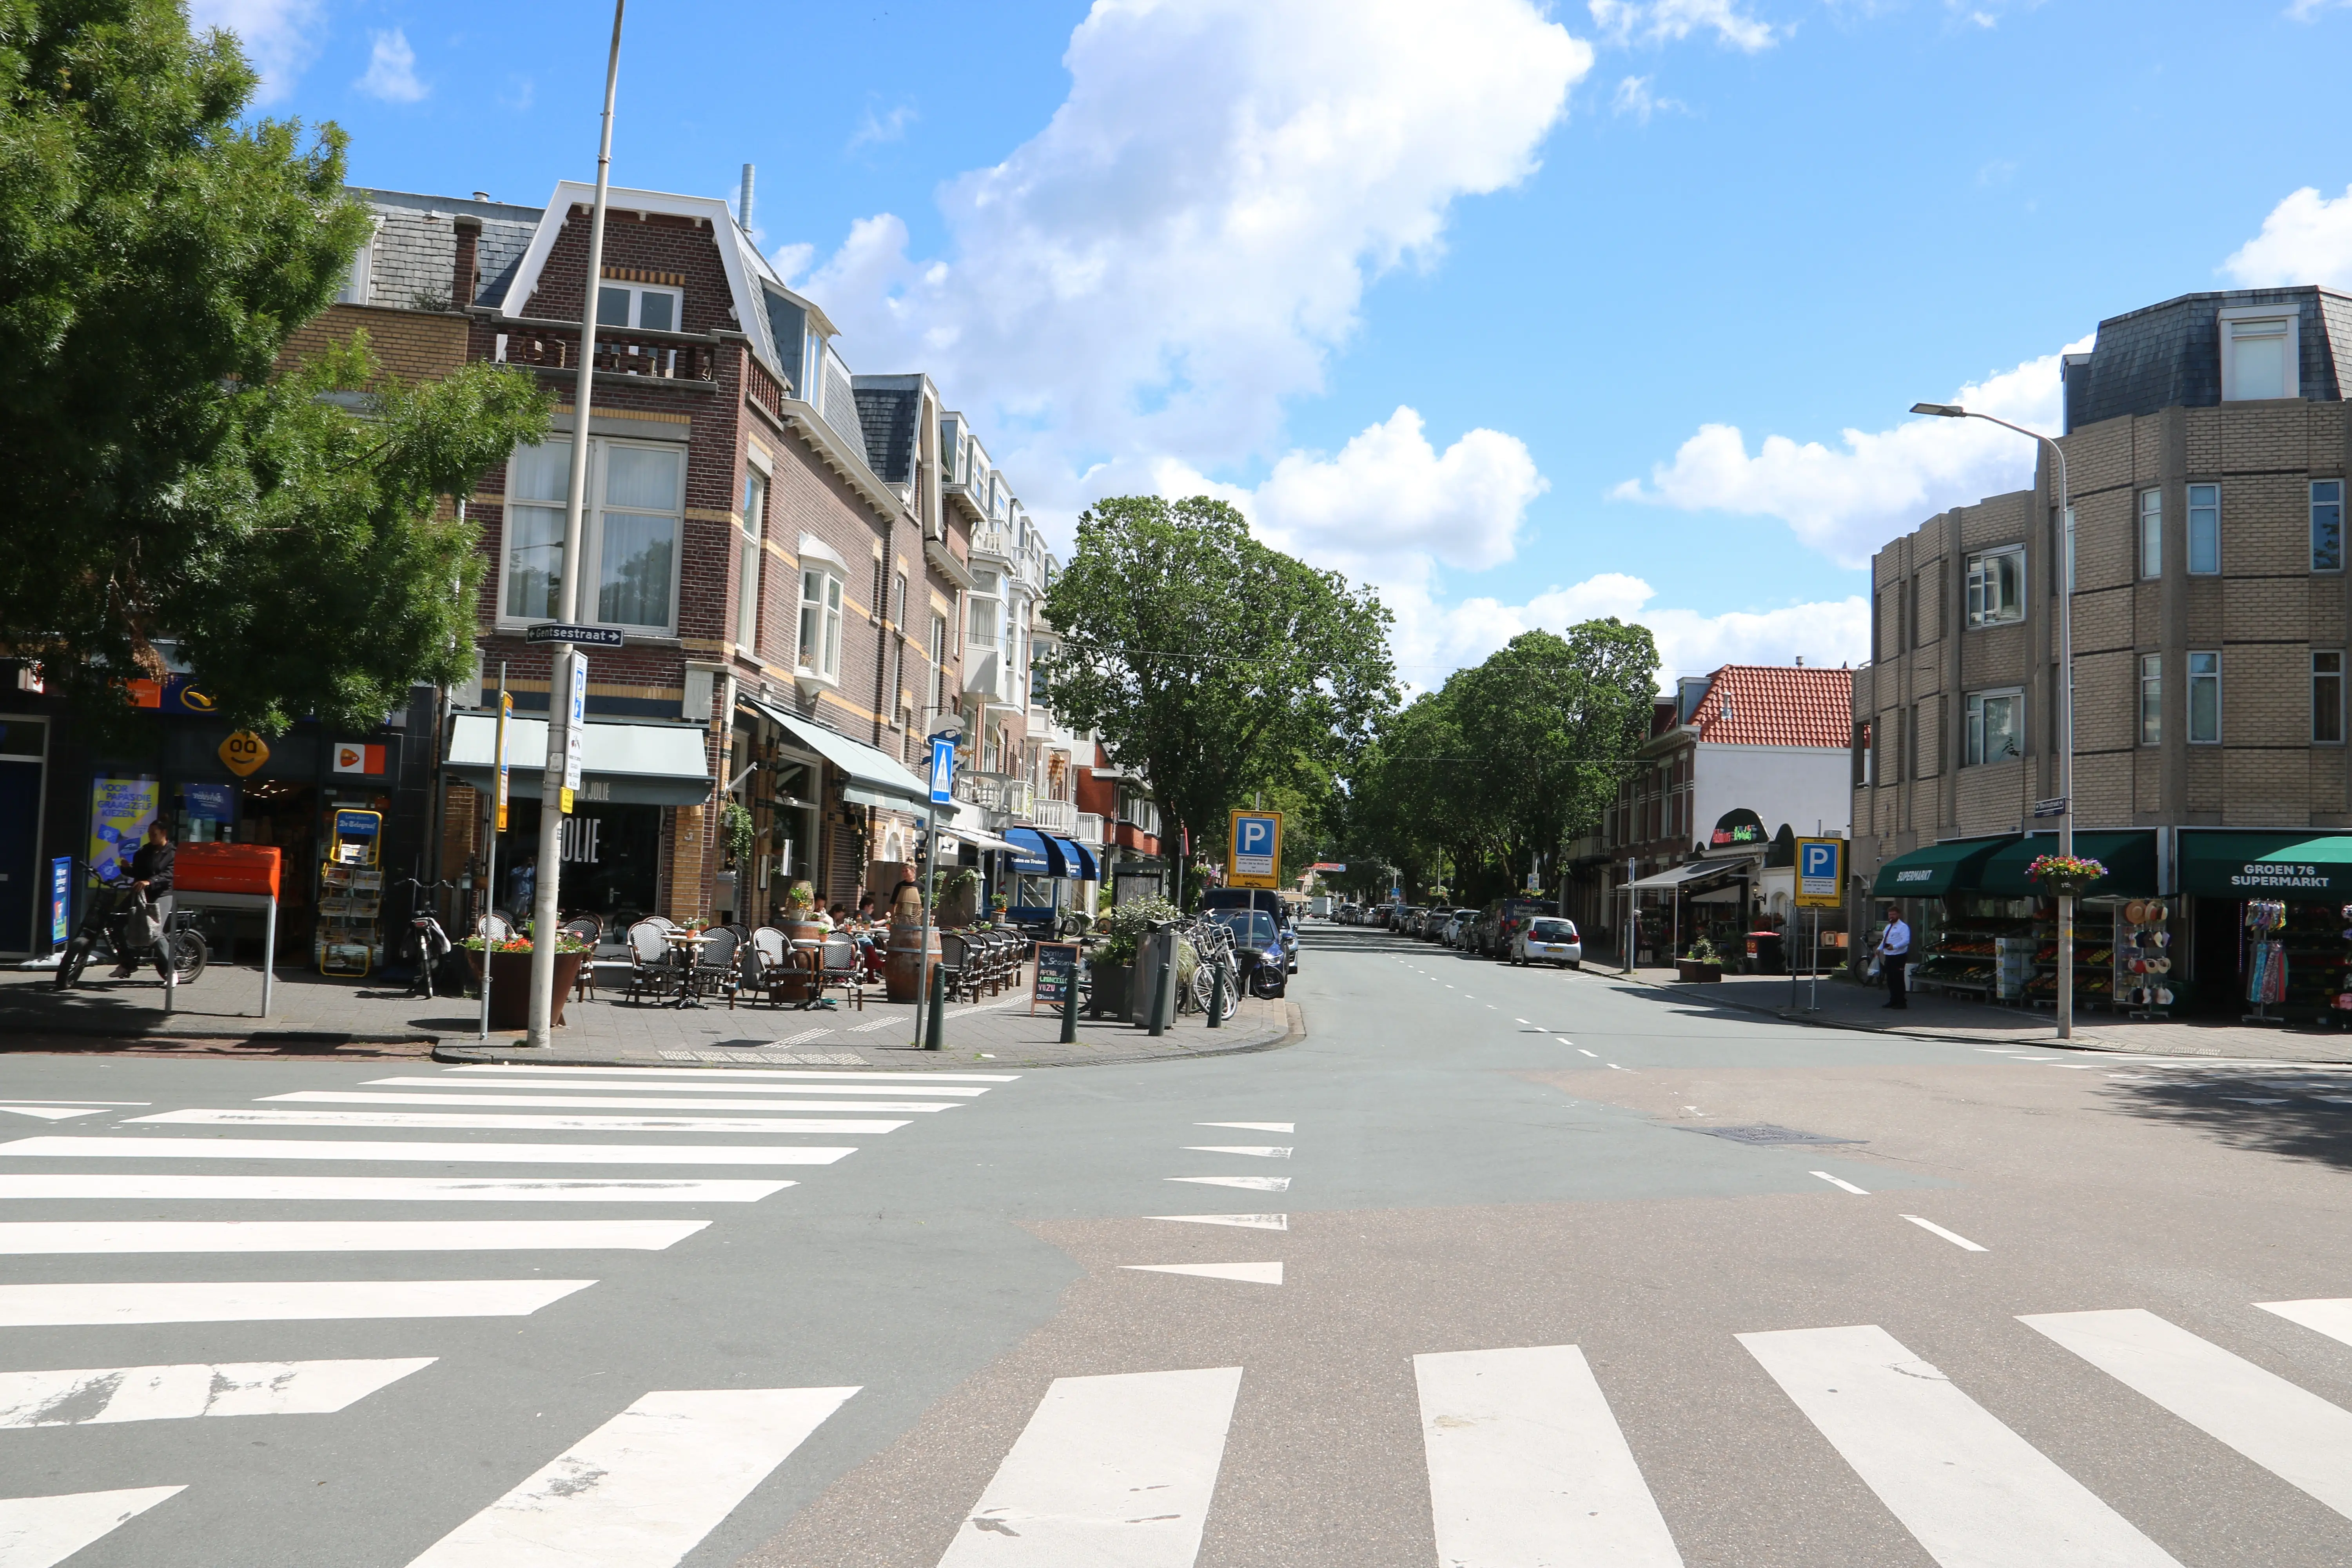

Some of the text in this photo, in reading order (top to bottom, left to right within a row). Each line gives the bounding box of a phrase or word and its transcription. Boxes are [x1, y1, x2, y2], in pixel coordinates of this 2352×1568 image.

[536, 628, 606, 640] Gentsestraat
[101, 784, 129, 792] VOOR
[588, 782, 610, 800] JOLIE
[97, 800, 130, 809] GRAAG
[561, 817, 601, 863] OLIE
[1245, 823, 1266, 851] P
[1809, 848, 1828, 874] P
[1896, 869, 1933, 882] SUPERMARKT
[2244, 864, 2315, 875] GROEN 76
[2231, 875, 2329, 887] SUPERMARKT
[1041, 947, 1064, 958] Spritz
